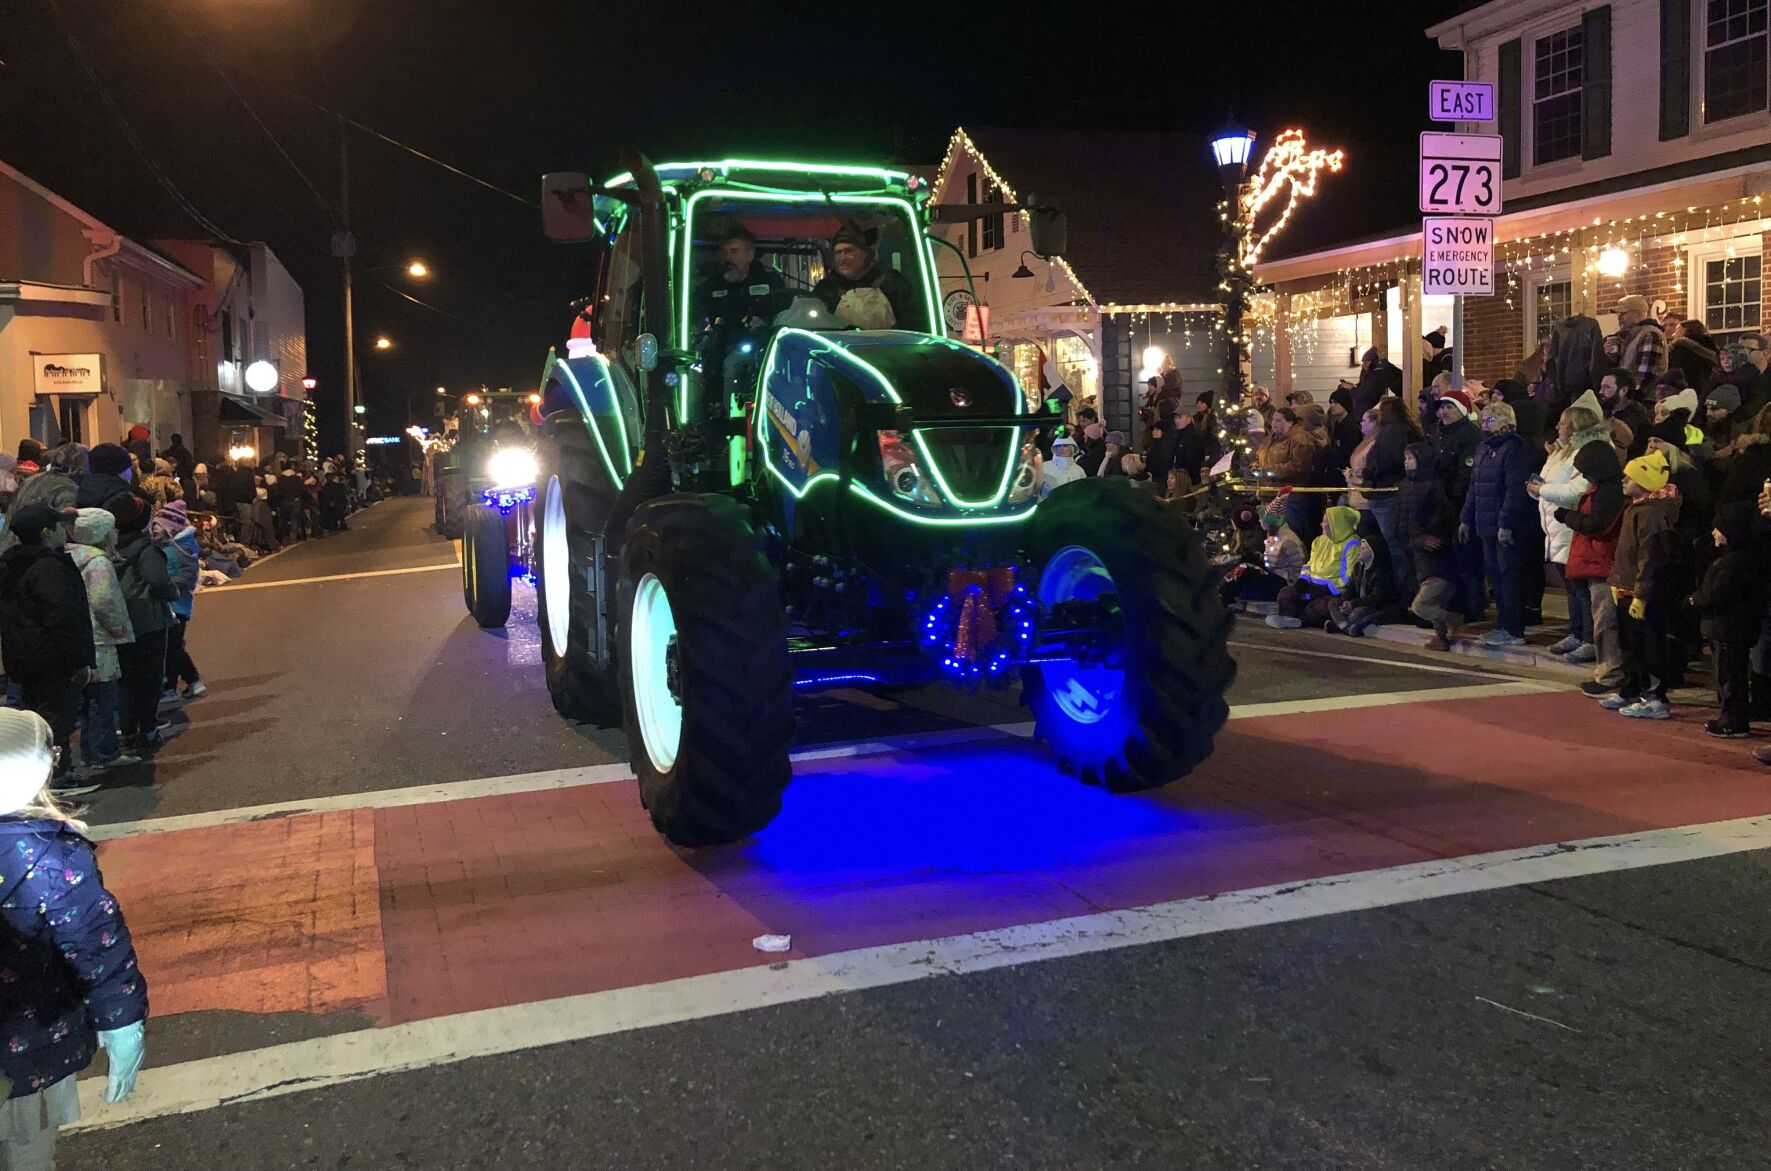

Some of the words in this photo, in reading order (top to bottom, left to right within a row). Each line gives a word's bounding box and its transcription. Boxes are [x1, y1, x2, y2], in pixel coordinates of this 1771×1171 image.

[1440, 88, 1484, 114] EAST
[1429, 163, 1493, 207] 273
[1431, 226, 1488, 245] SNOW
[1430, 250, 1488, 263] EMERGENCY
[1428, 267, 1489, 286] ROUTE
